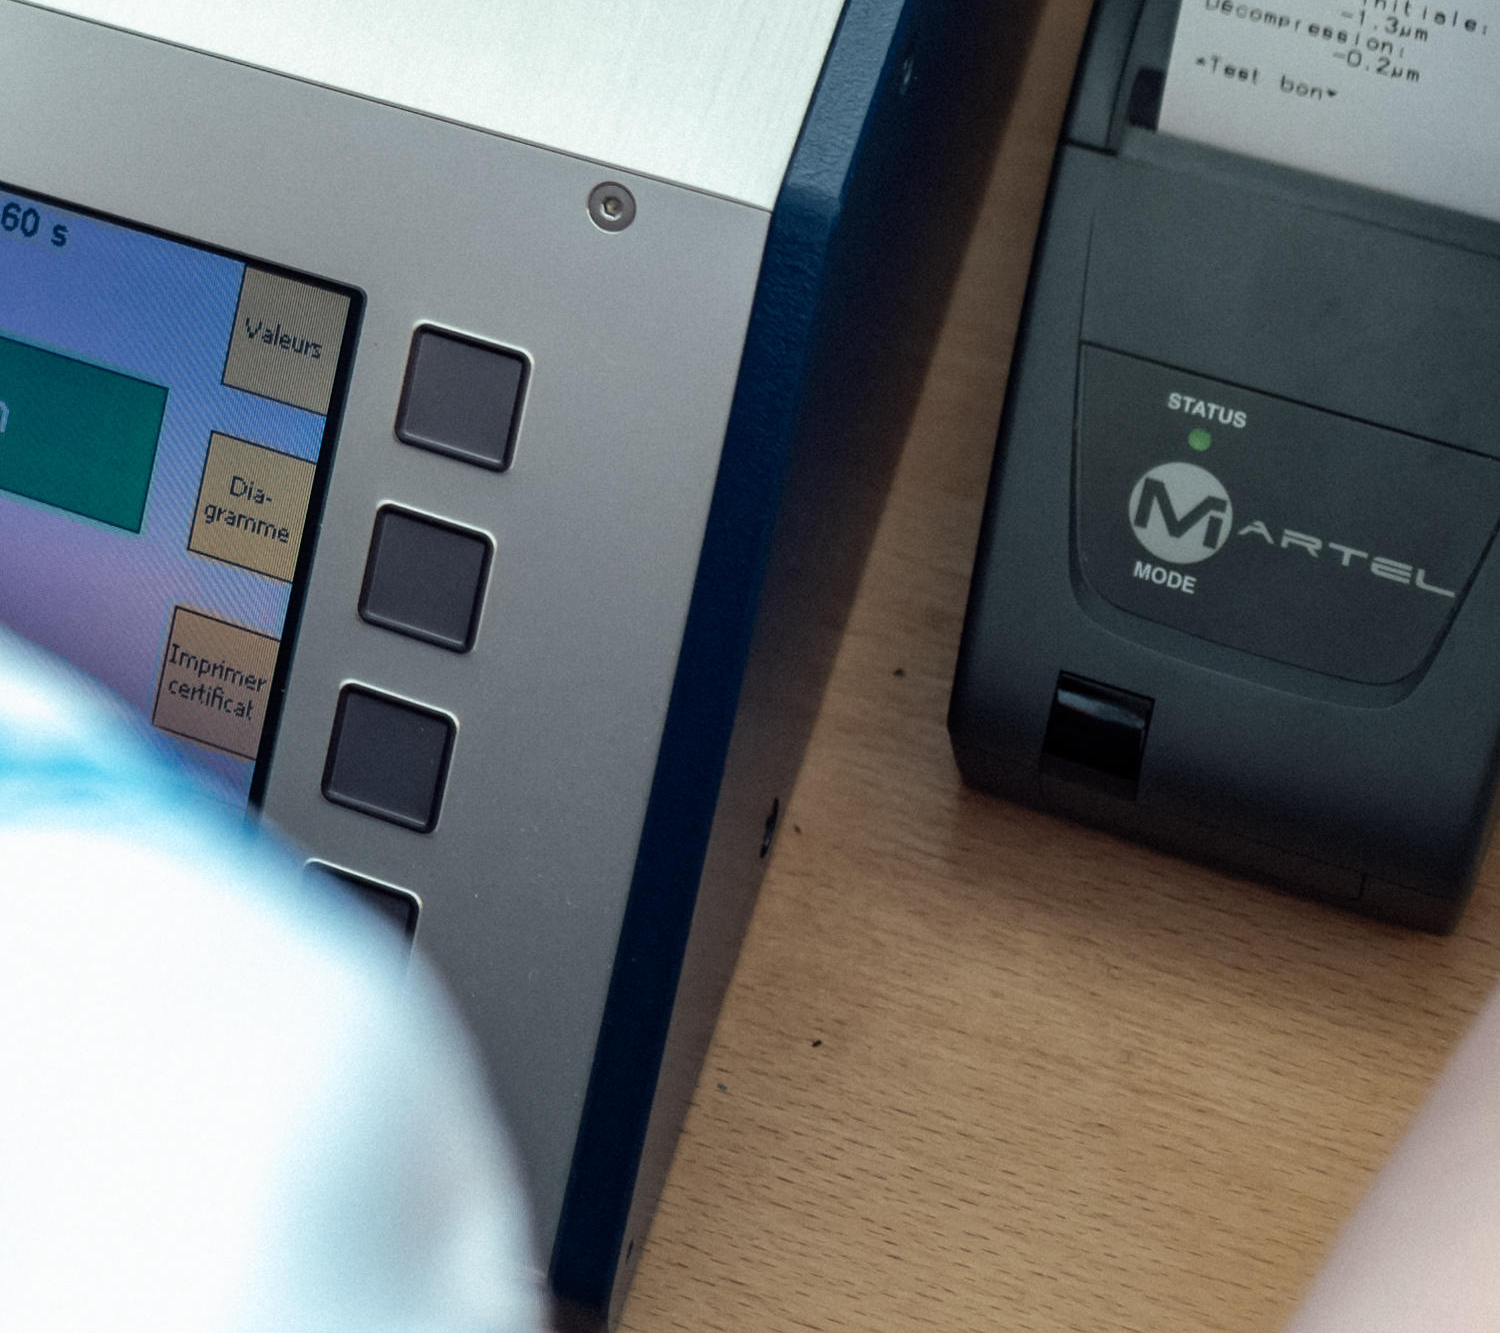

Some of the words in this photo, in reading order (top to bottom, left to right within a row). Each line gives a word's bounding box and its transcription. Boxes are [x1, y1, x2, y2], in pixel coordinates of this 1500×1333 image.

[0, 201, 41, 238] 60
[50, 223, 70, 248] s
[245, 316, 323, 360] Valeurs
[1167, 391, 1248, 429] STATUS
[229, 475, 273, 505] Dia-
[204, 503, 291, 544] gramme
[1132, 560, 1198, 595] MODE
[168, 642, 268, 693] Imprimer
[167, 679, 255, 721] certificat
